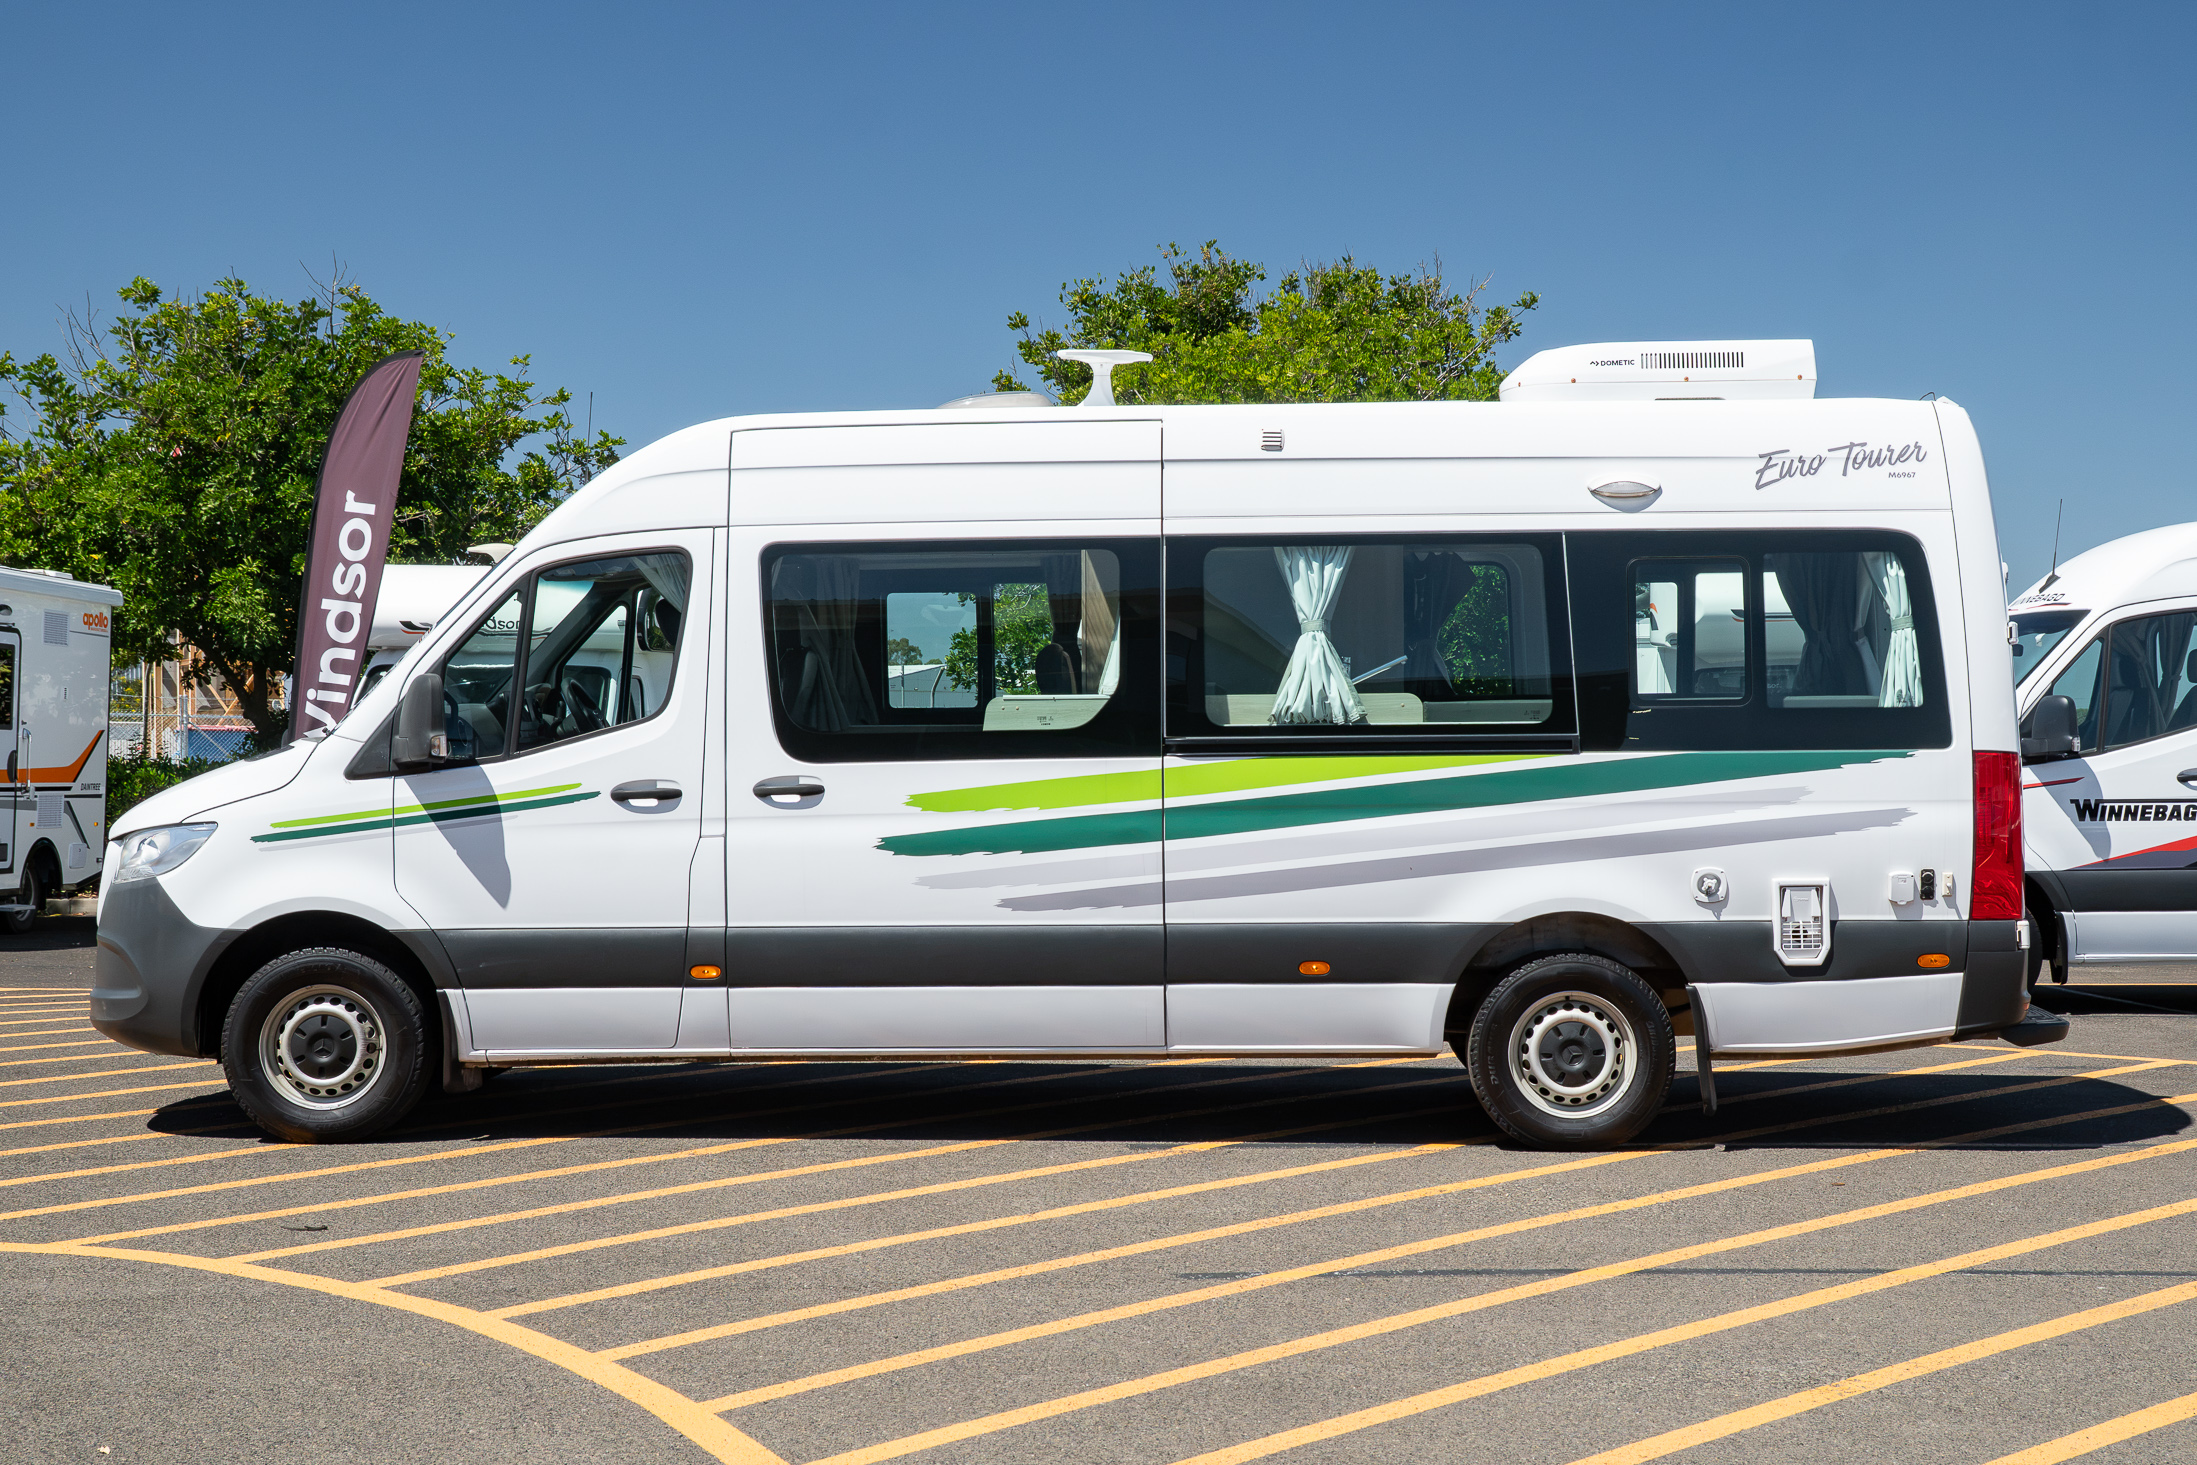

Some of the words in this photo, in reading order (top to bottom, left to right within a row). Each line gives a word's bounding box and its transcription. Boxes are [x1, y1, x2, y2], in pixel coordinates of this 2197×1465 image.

[1755, 449, 1827, 490] Euro
[1828, 441, 1927, 477] Tourer
[82, 611, 109, 630] apollo
[80, 783, 101, 791] DAINTREE
[2069, 799, 2197, 822] WINNEBAG
